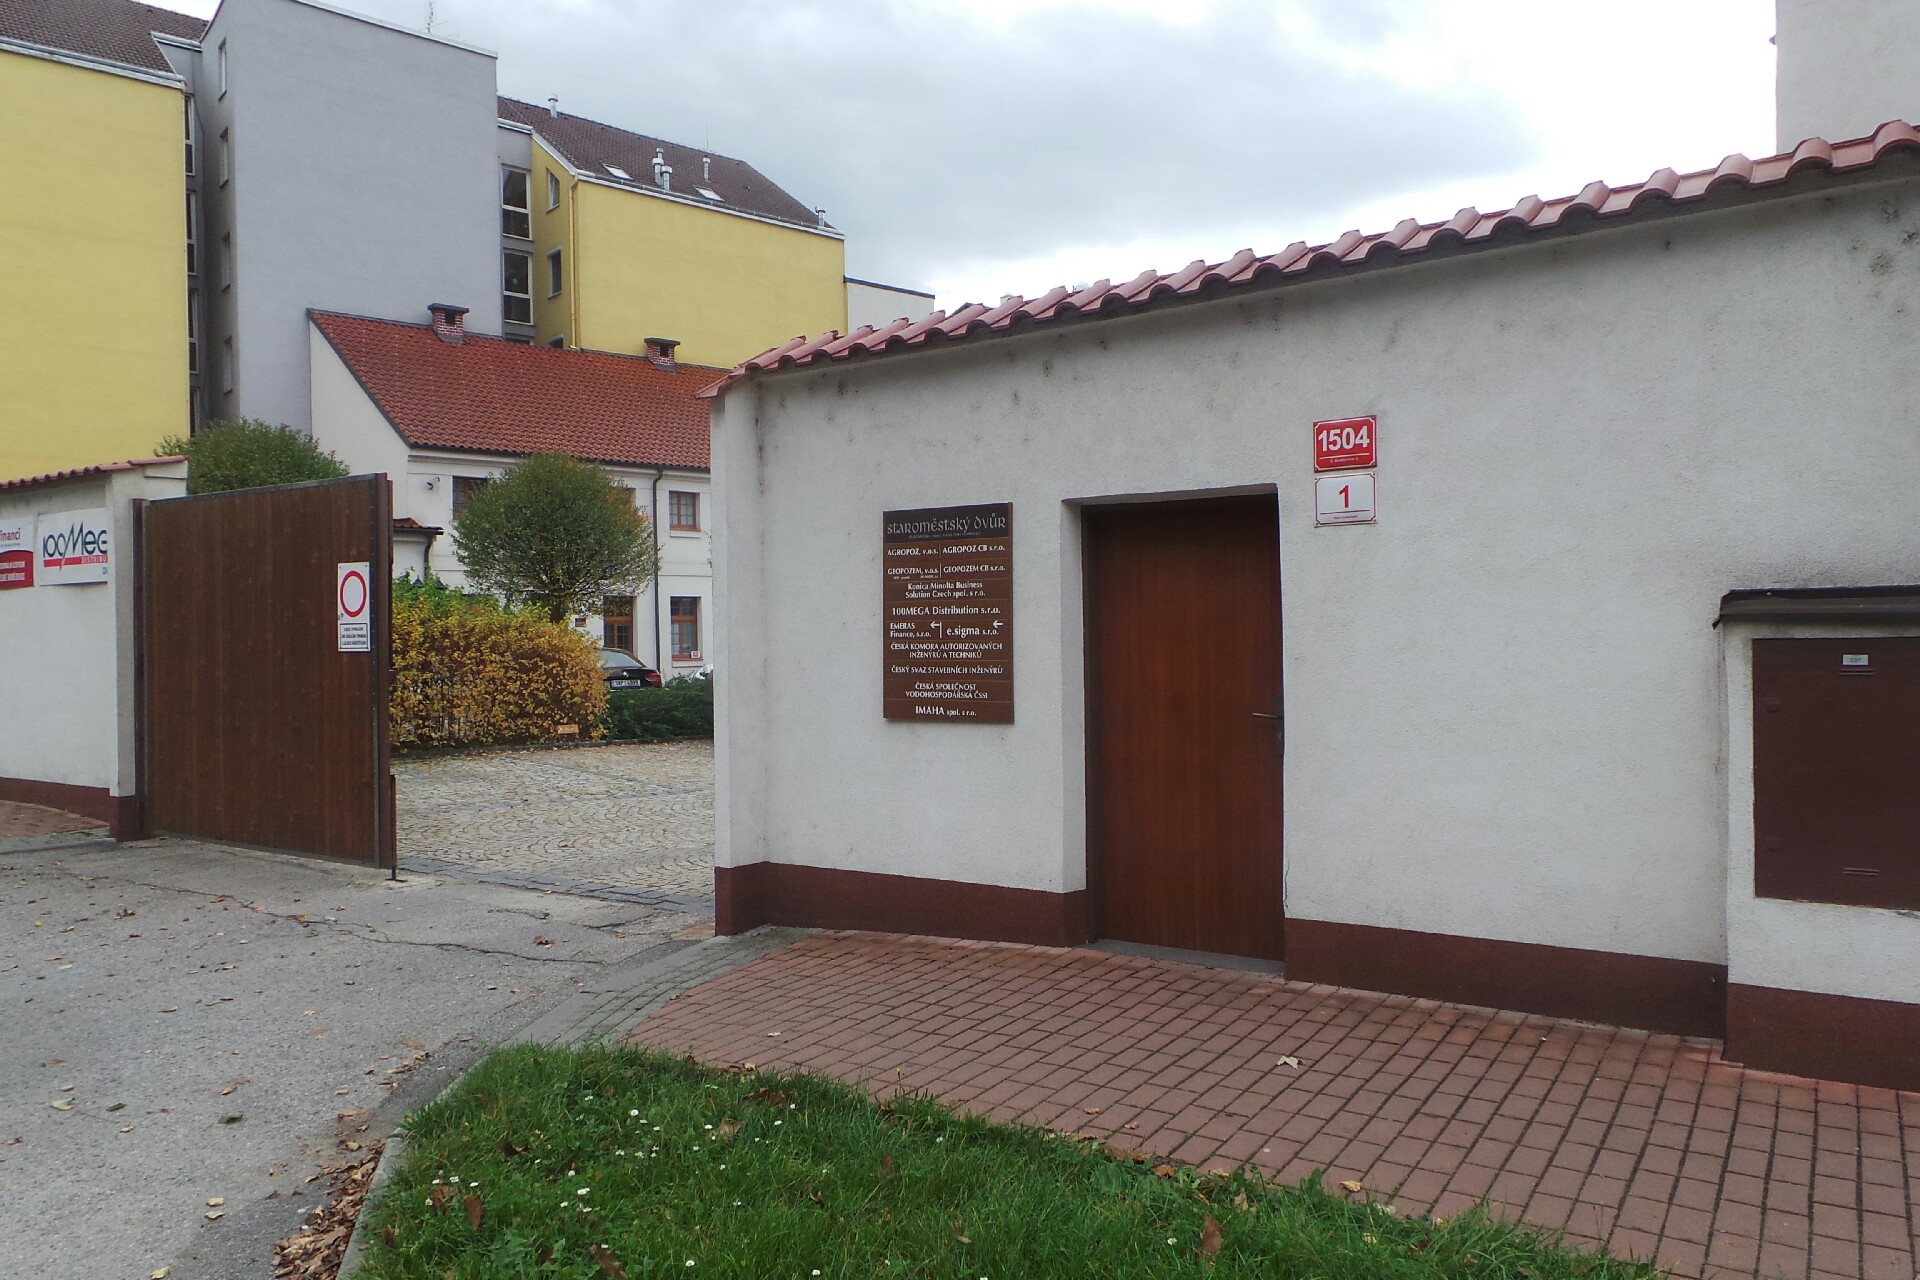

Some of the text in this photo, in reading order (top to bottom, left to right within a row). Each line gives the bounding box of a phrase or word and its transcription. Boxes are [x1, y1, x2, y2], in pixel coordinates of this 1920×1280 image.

[1318, 425, 1370, 452] 1504
[1338, 485, 1349, 508] 1
[888, 548, 921, 556] AGROPOZ,
[942, 545, 977, 554] AGROPOZ
[888, 567, 923, 575] GEOPOZEM,
[943, 565, 979, 573] GEOPOZEM
[905, 591, 930, 599] Solution
[953, 590, 968, 598] spol.
[892, 607, 930, 615] 100MEGA
[932, 606, 979, 615] Distribution
[890, 630, 915, 638] Finance,
[947, 625, 980, 638] e.sigma
[891, 642, 910, 650] ČESKÁ
[940, 642, 1002, 650] AUTORIZOVANÝCH
[910, 650, 941, 658] INŽENÝRŮ
[891, 665, 910, 673] ČESKÝ
[928, 665, 968, 674] STAVEBNÍCH
[970, 665, 1003, 674] INŽENÝRŮ
[936, 682, 977, 690] SPOLEČNOST
[905, 691, 973, 699] VODOHOSPODÁŘSKÁ
[916, 706, 944, 715] IMAHA
[947, 709, 960, 717] spol.
